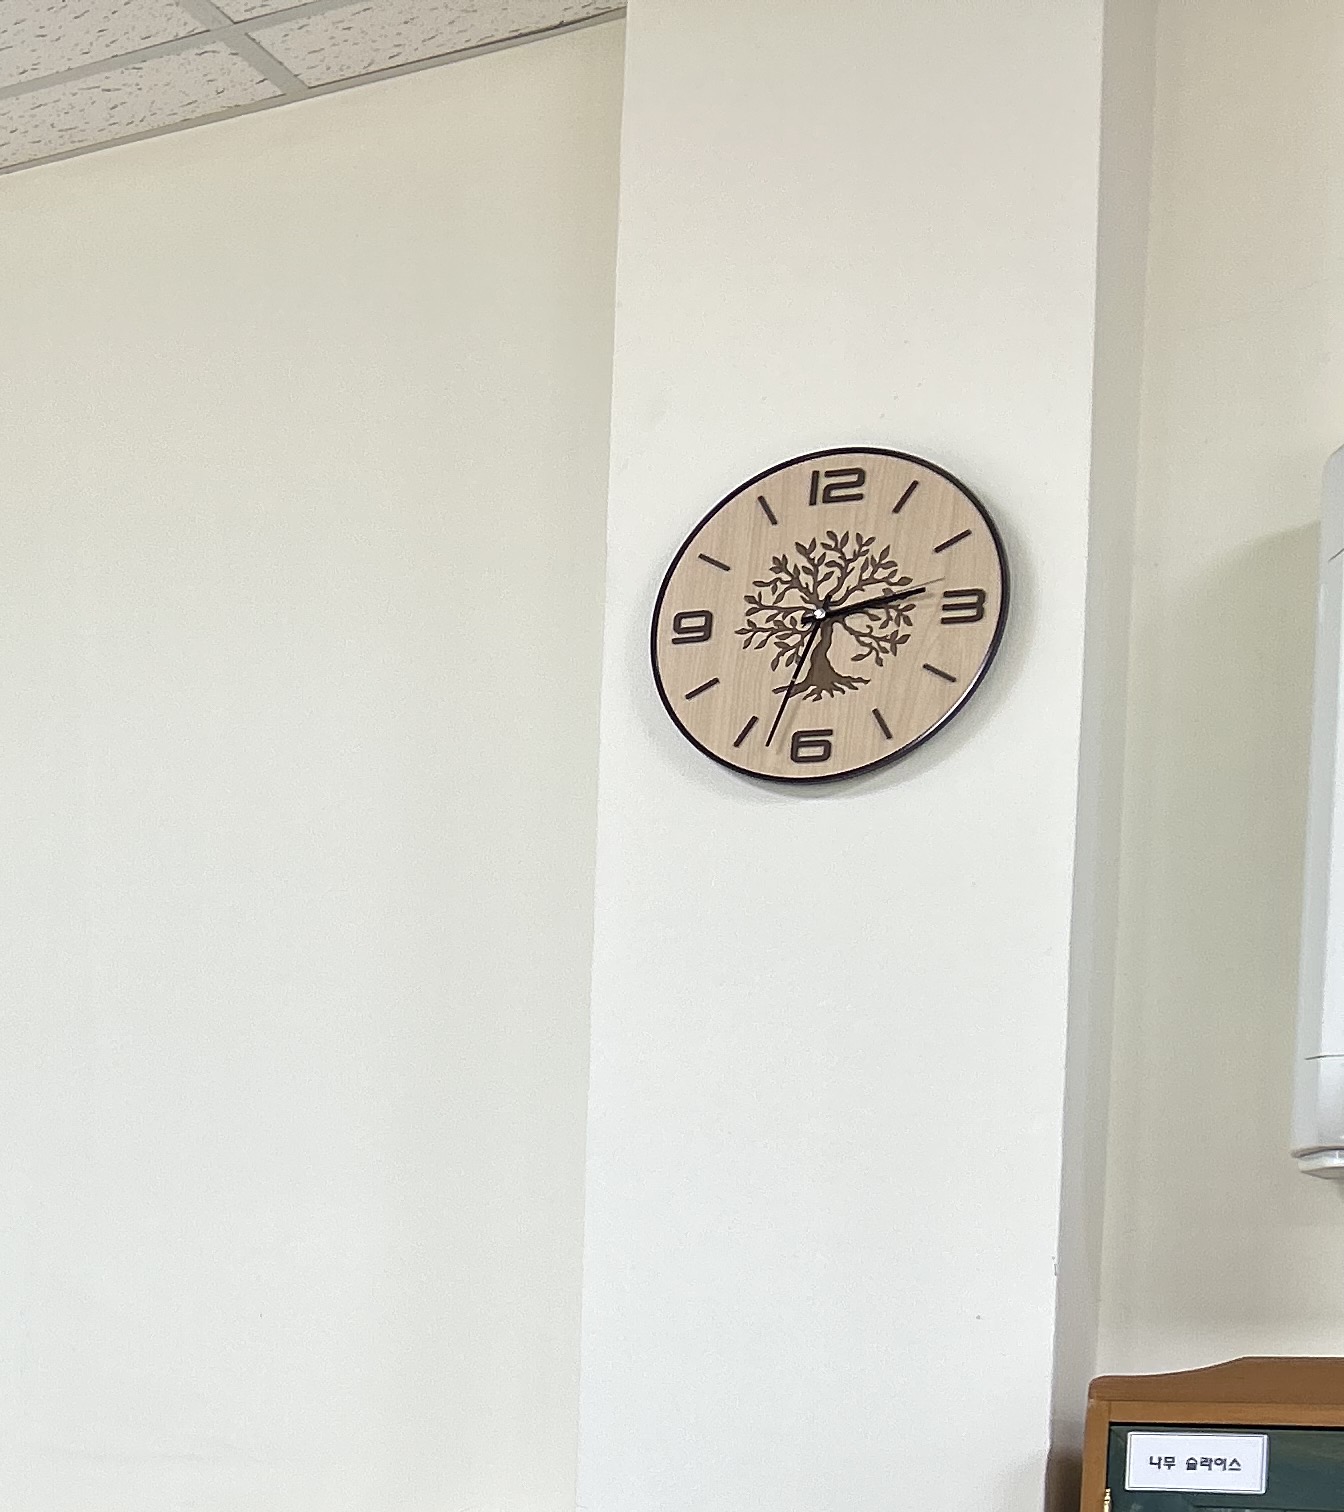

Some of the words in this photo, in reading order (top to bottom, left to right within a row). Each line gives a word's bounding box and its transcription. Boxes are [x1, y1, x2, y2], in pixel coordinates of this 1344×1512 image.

[809, 467, 866, 506] 12
[941, 587, 987, 625] 3
[672, 609, 713, 645] 9
[791, 728, 834, 763] 6
[1149, 1456, 1176, 1470] 나무
[1185, 1456, 1242, 1471] 슬라이스
